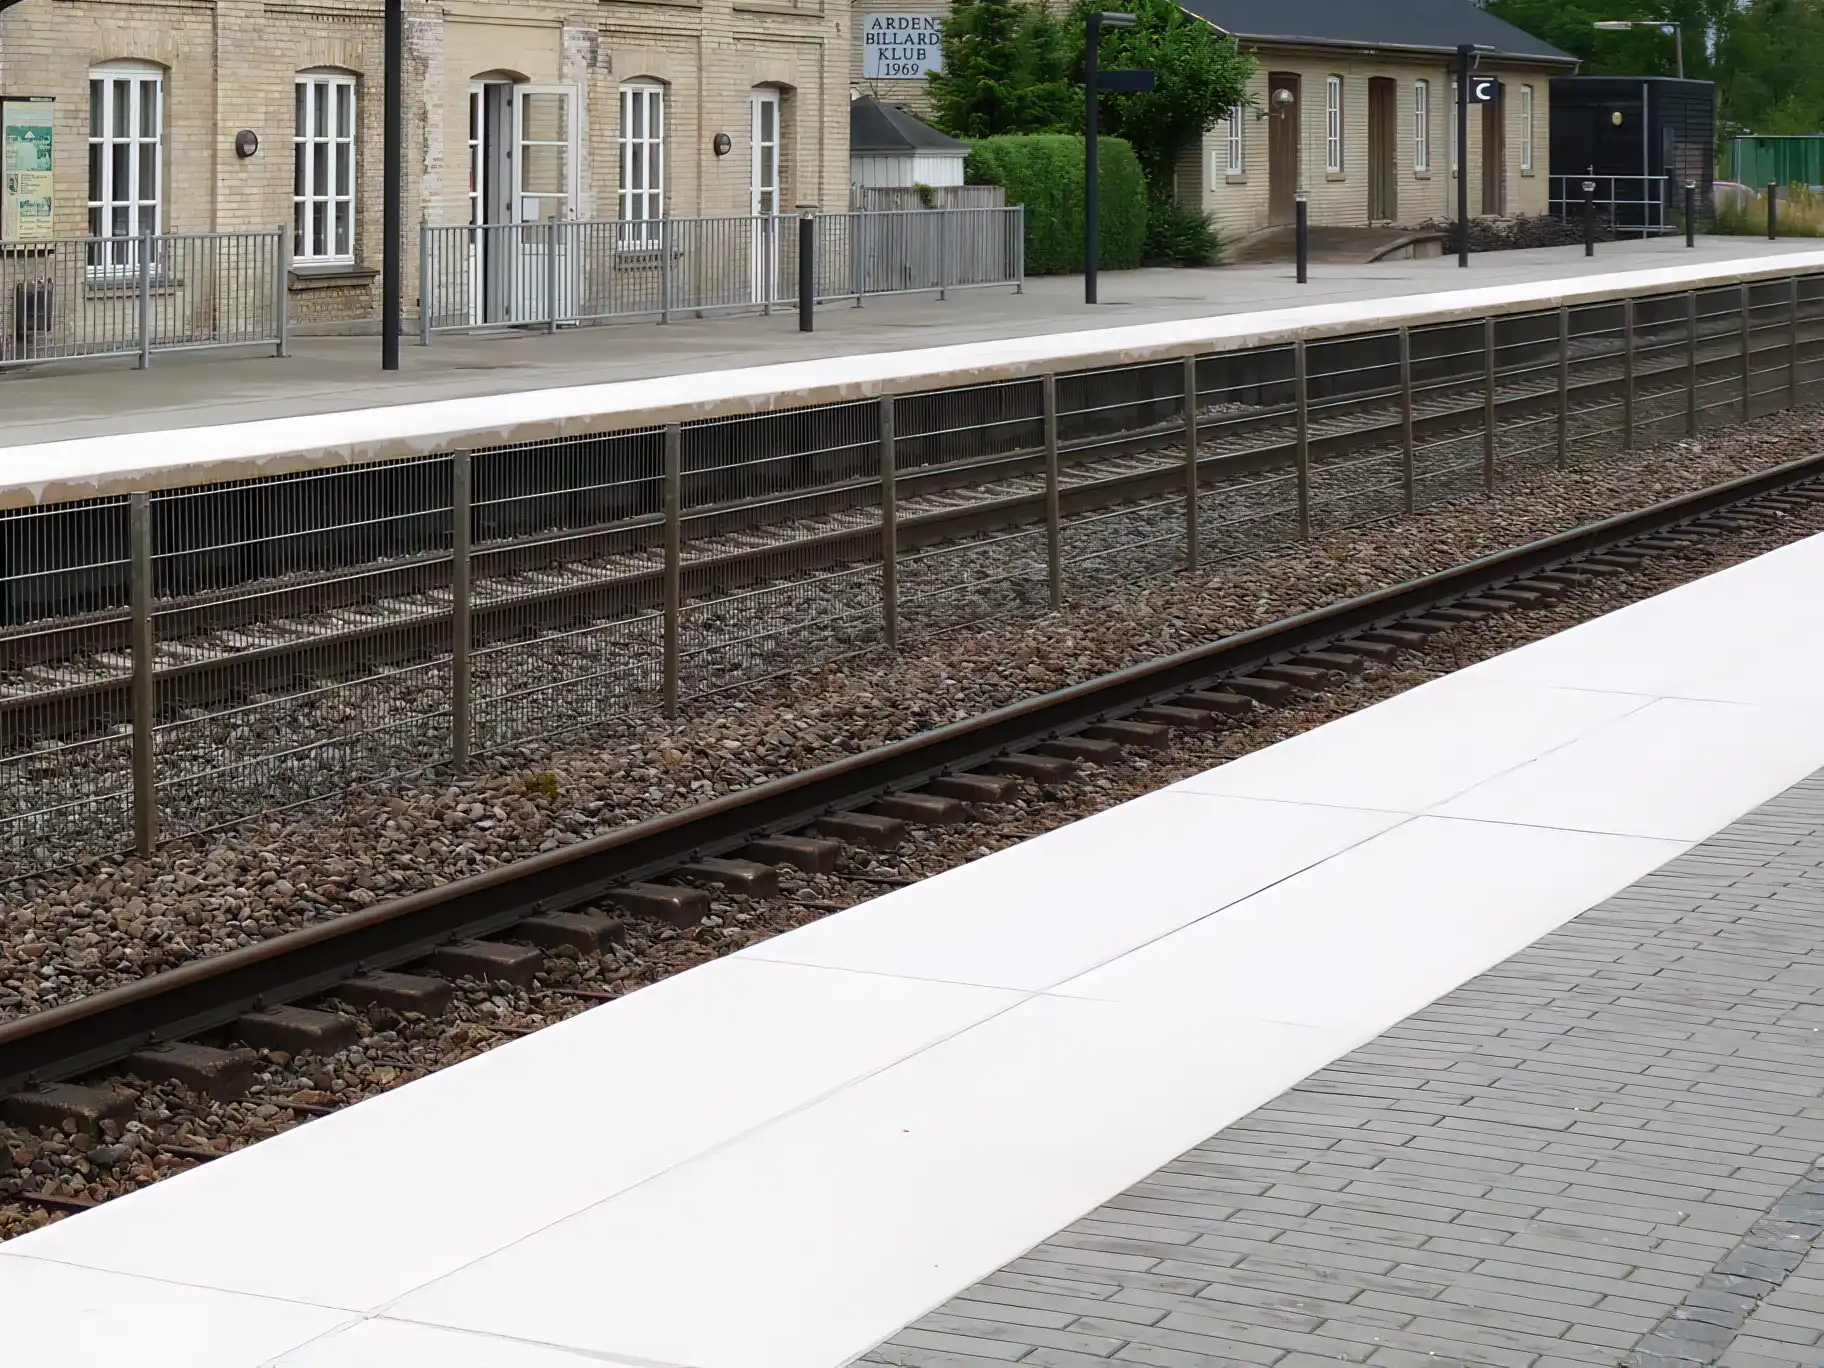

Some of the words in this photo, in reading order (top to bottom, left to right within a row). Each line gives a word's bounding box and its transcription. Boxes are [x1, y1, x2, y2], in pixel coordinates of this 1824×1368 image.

[871, 17, 936, 30] ARDEN
[866, 32, 940, 45] BILLARD
[878, 48, 927, 61] KLUB
[885, 63, 920, 75] 1969
[1476, 82, 1491, 100] C
